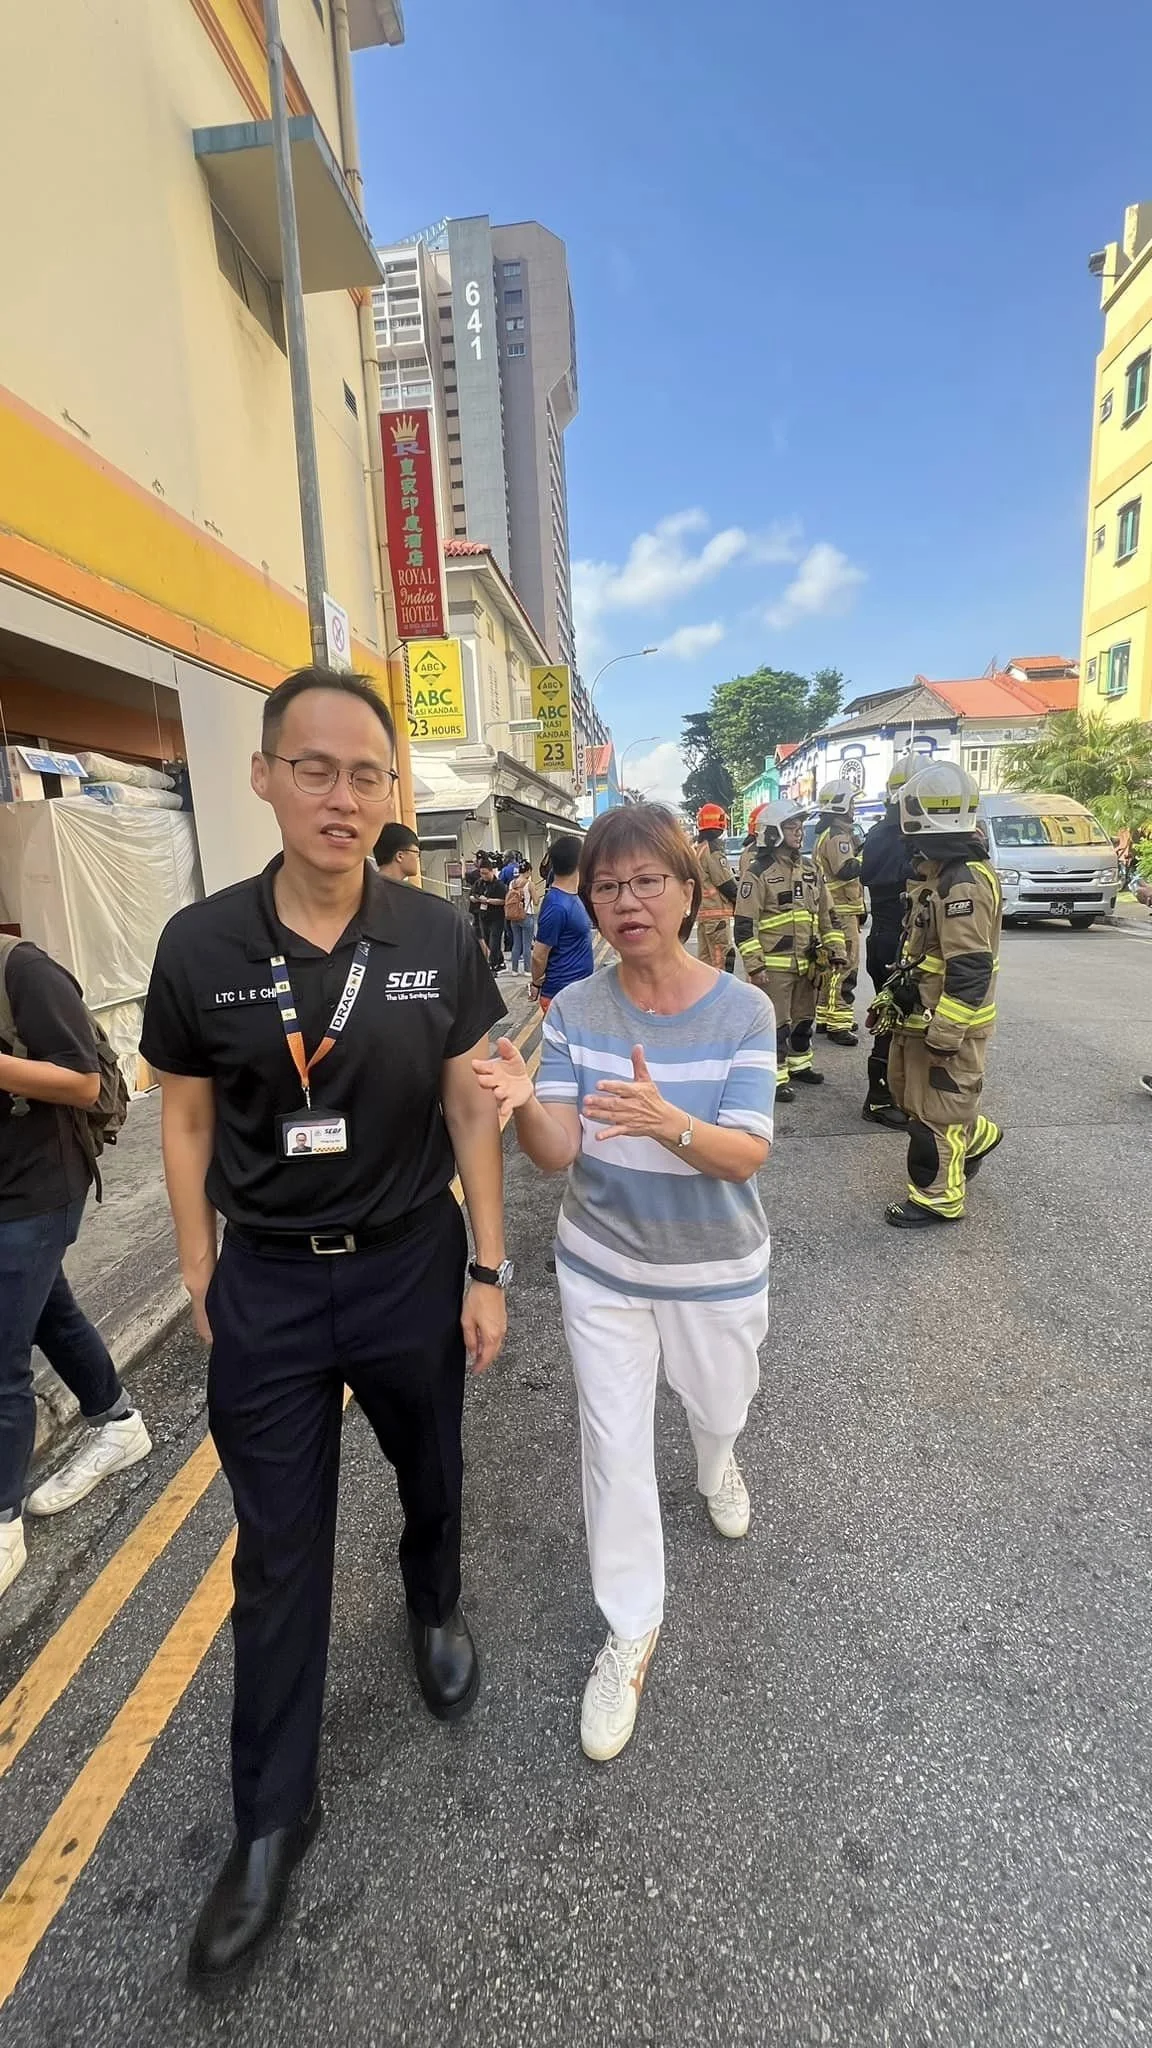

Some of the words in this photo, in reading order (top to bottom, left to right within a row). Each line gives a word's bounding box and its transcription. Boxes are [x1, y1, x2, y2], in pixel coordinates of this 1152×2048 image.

[465, 280, 483, 361] 641
[392, 440, 425, 456] R
[398, 567, 435, 586] ROYAL
[400, 587, 436, 606] India
[402, 604, 438, 623] HOTEL
[421, 663, 440, 672] ABC
[541, 681, 558, 690] ABC
[414, 688, 453, 707] ABC
[415, 708, 426, 716] ASI
[428, 705, 460, 714] KANDAR
[537, 704, 568, 721] ABC
[410, 719, 429, 737] 23
[431, 725, 461, 736] HOURS
[543, 720, 562, 729] NASI
[537, 730, 569, 738] KANDAR
[543, 743, 565, 761] 23
[386, 970, 438, 988] SCDF
[216, 991, 235, 1003] LTC
[239, 990, 246, 1001] L
[250, 989, 257, 1000] E
